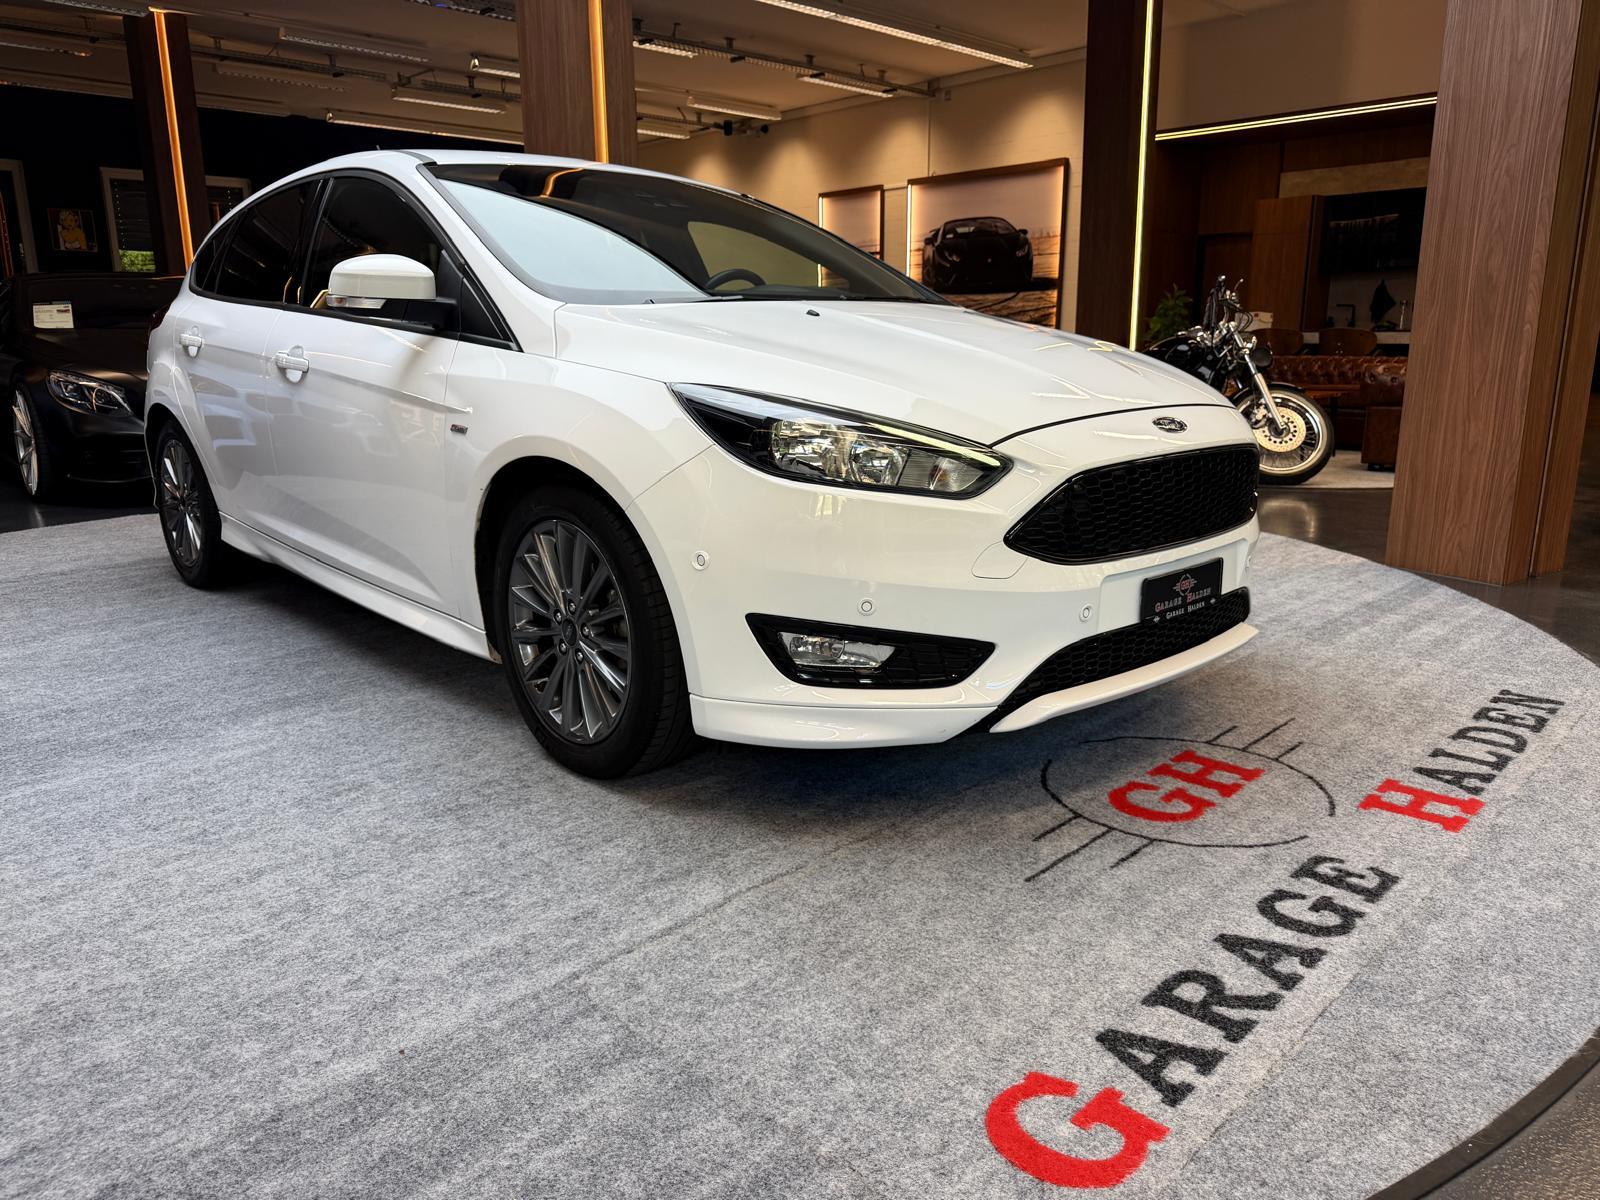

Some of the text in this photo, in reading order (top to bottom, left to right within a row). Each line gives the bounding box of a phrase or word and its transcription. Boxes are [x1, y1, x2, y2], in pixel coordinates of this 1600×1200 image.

[1154, 587, 1212, 613] GARAGE HALDEN
[1165, 601, 1205, 620] GARAGE HALDEN
[1108, 750, 1265, 823] GH
[984, 689, 1565, 1190] GARAGE HALDEN
